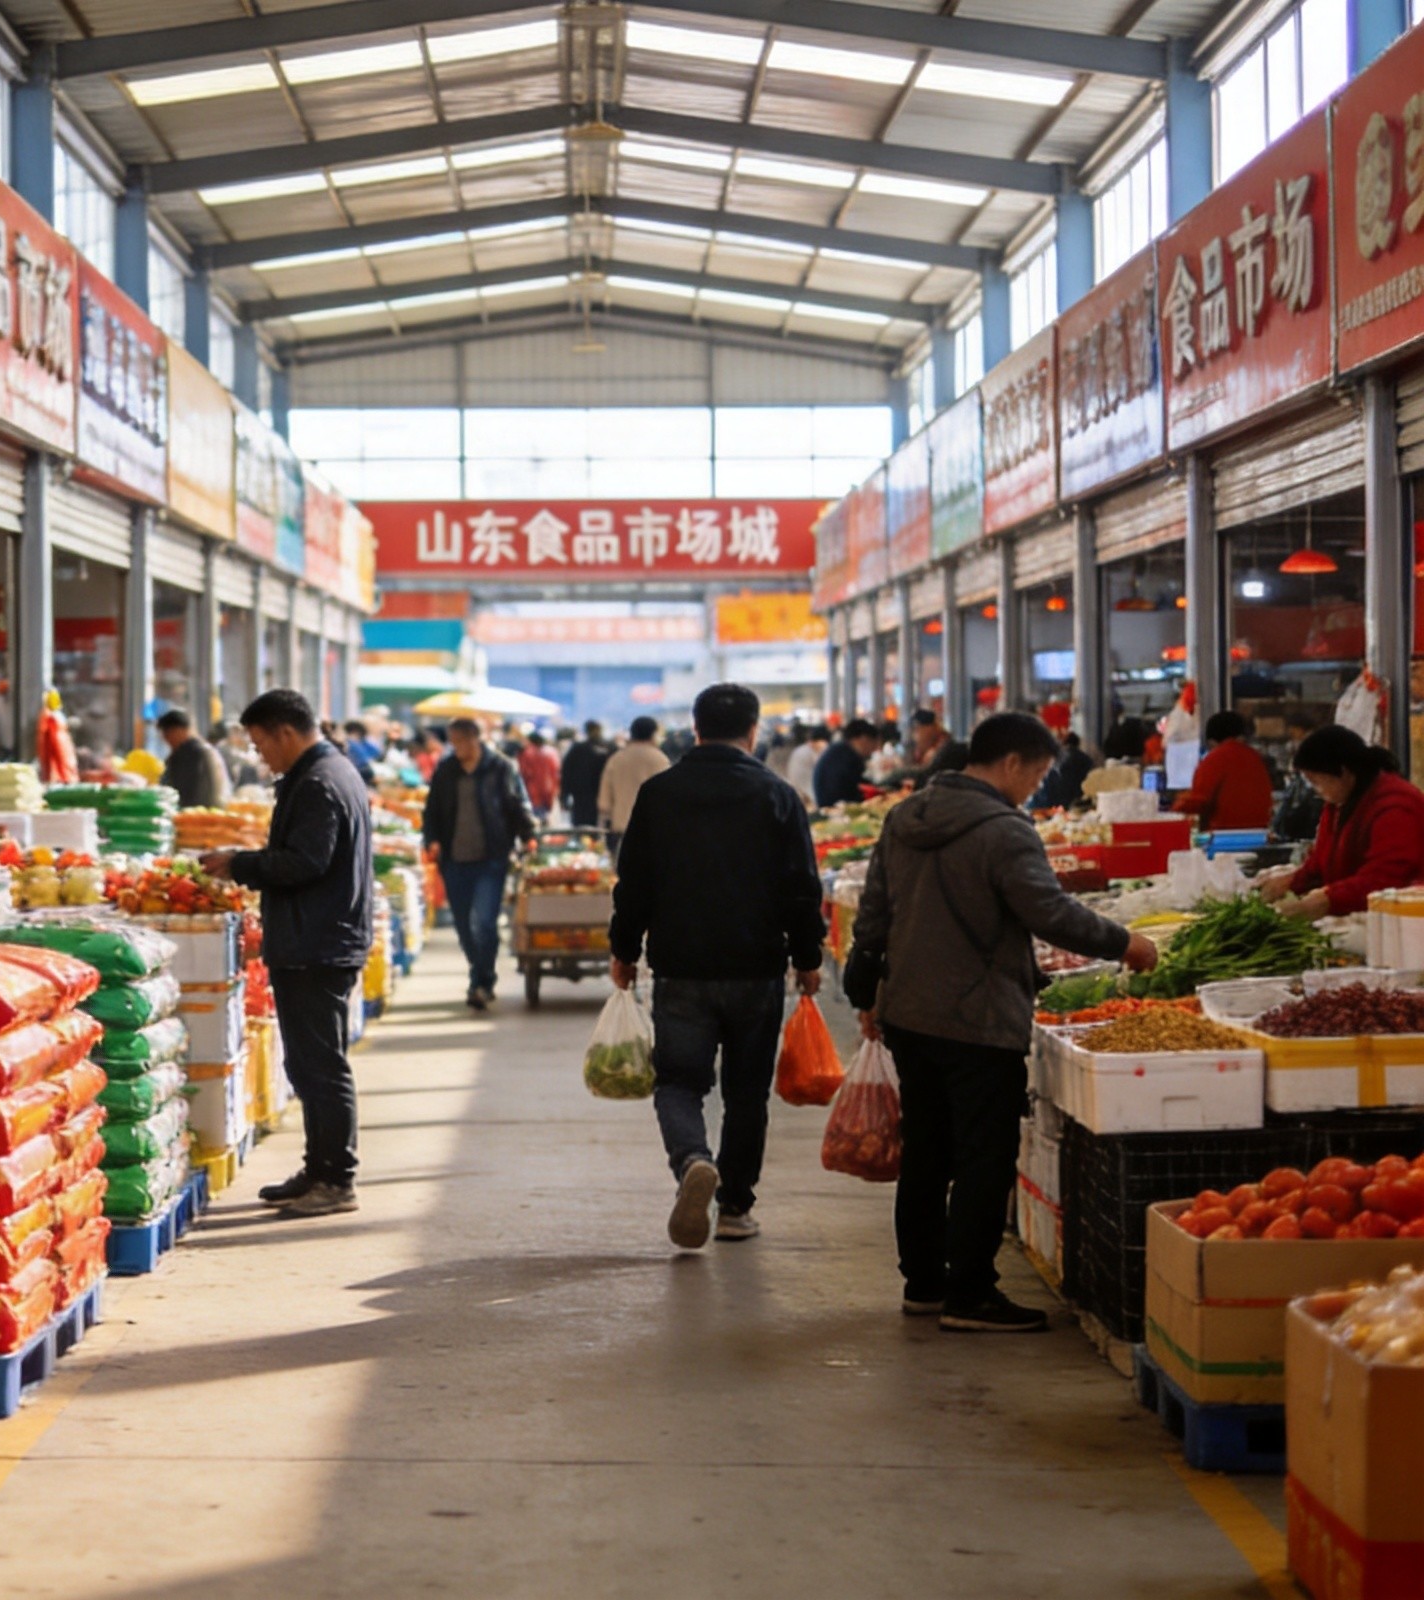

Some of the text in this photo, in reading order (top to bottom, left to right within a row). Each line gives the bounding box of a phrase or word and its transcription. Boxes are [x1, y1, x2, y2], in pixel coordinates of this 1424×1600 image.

[1163, 174, 1314, 378] 食品市场
[416, 506, 781, 567] 山东食品市场城
